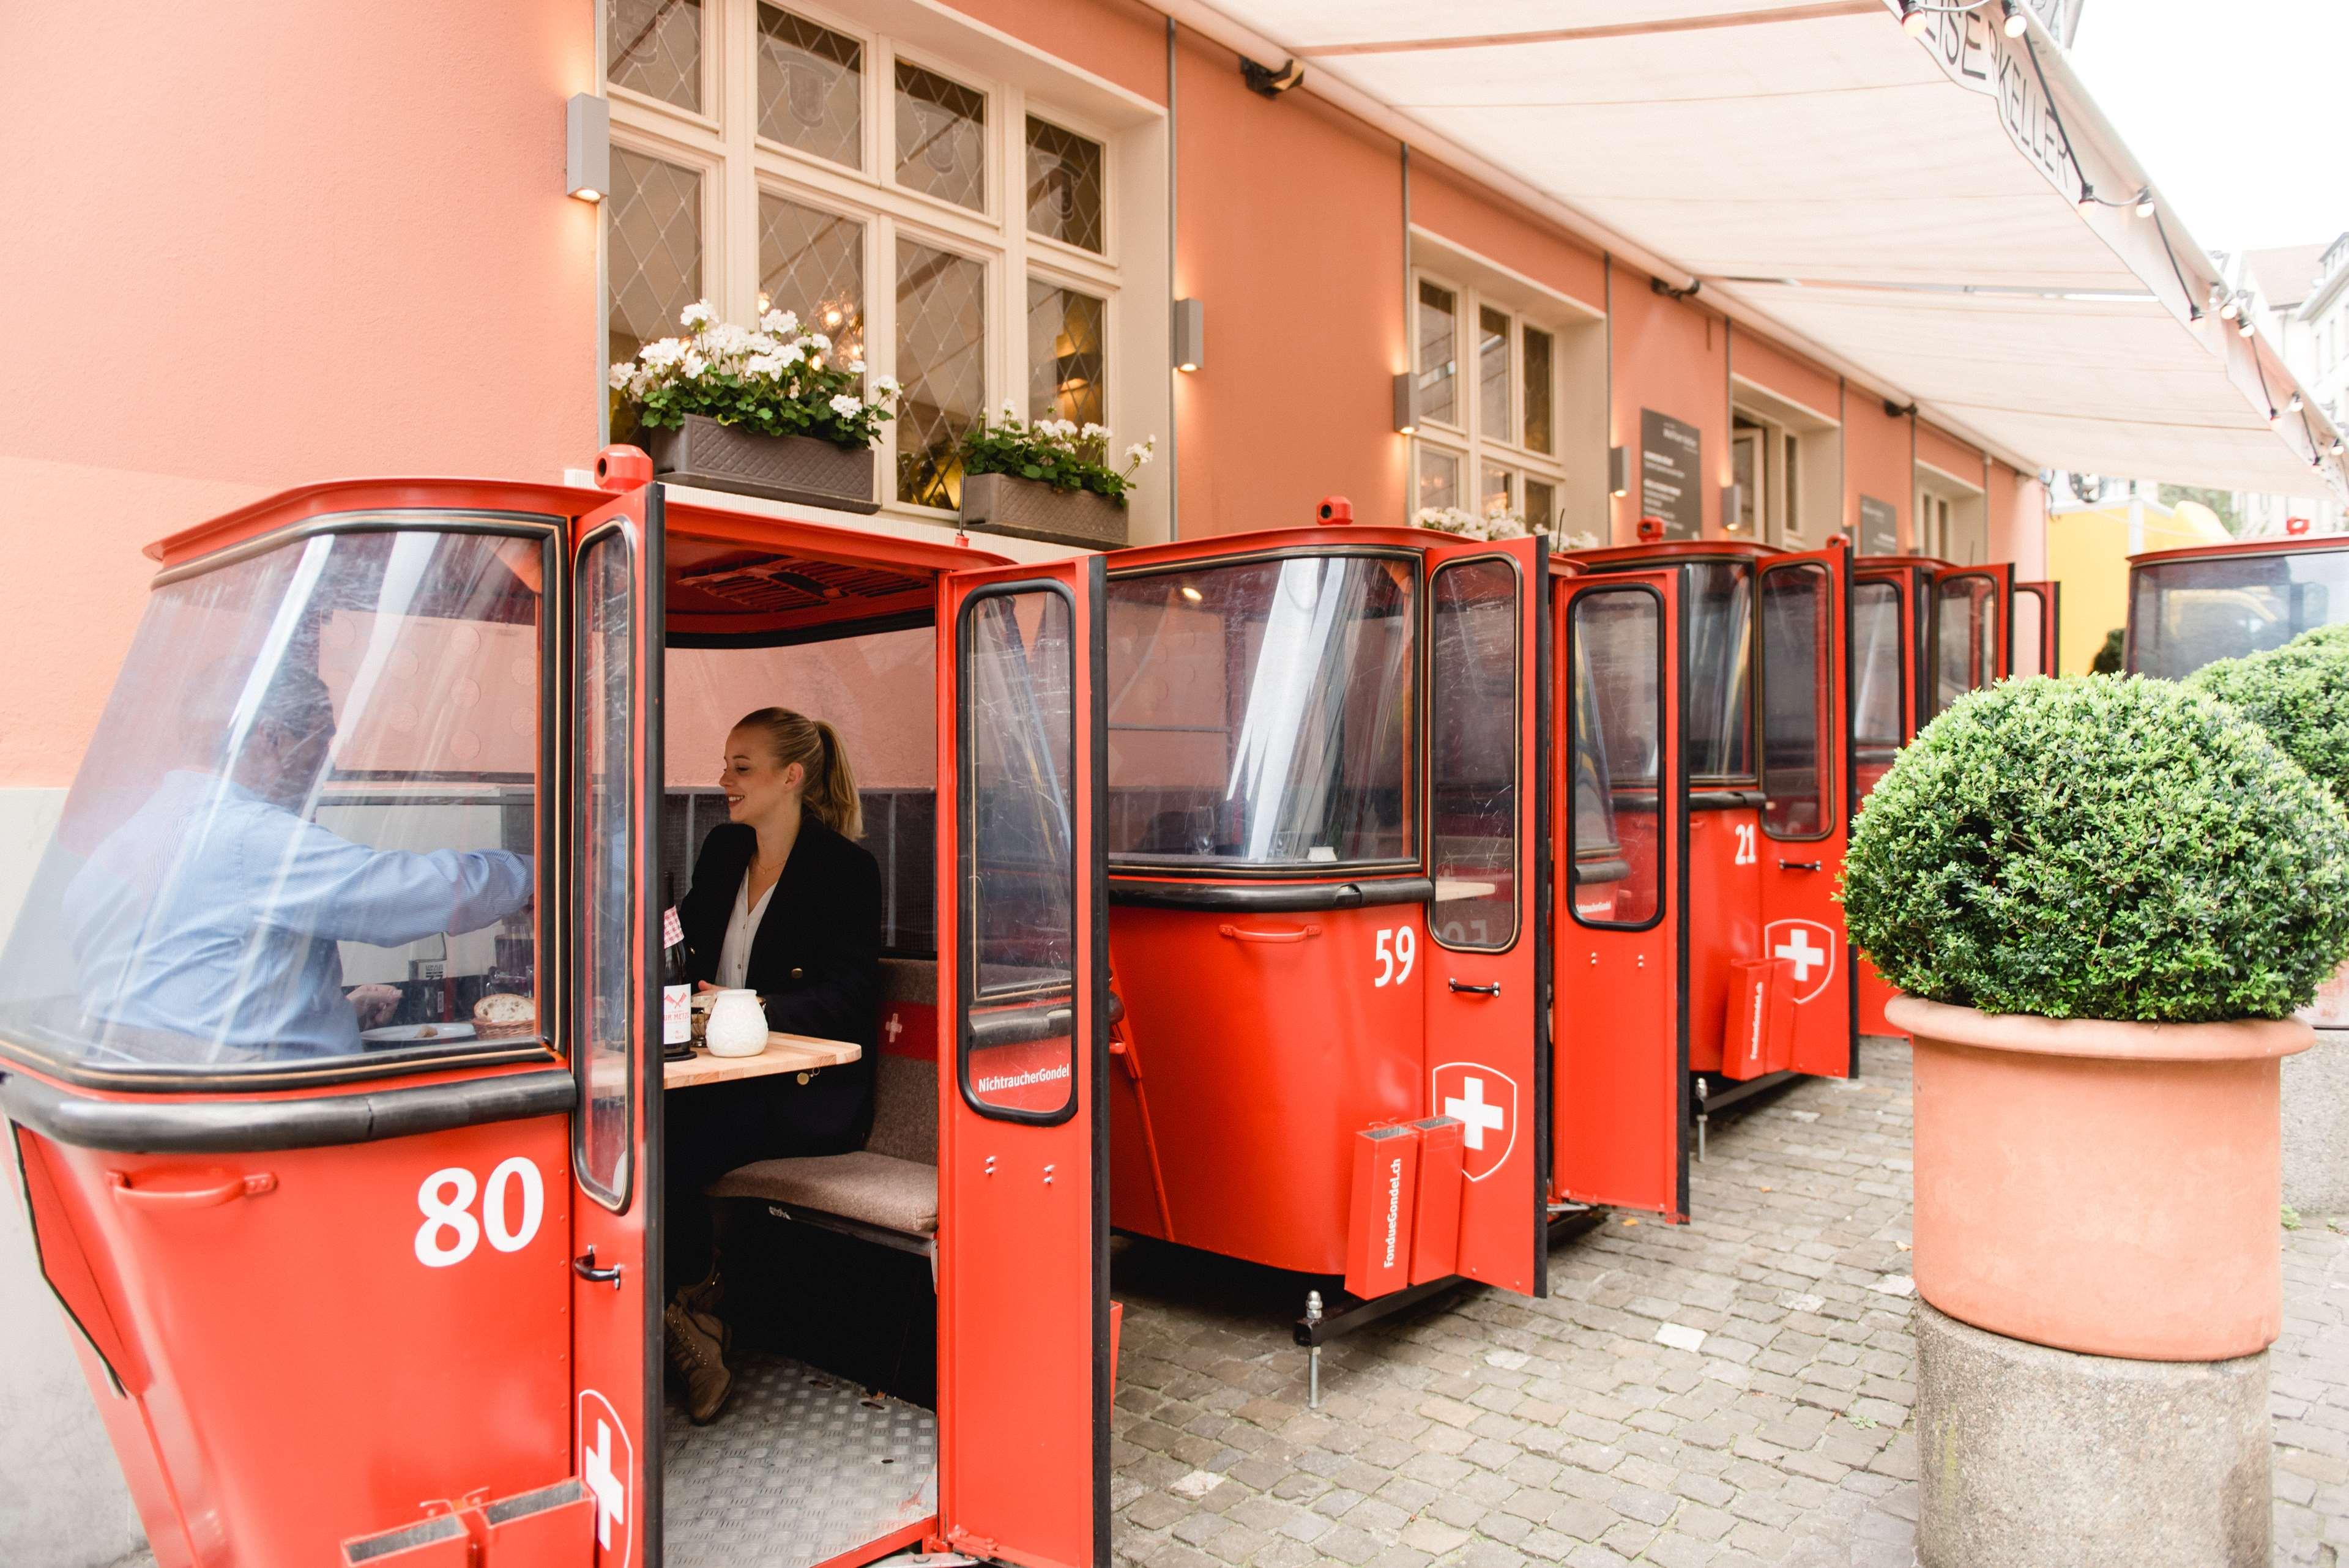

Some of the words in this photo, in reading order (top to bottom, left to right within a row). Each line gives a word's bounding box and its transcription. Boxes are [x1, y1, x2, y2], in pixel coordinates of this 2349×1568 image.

[1735, 823, 1756, 864] 21
[1374, 926, 1415, 987] 59
[978, 1063, 1070, 1093] NichtraucherGondel
[414, 1156, 545, 1268] 80
[1383, 1157, 1401, 1268] FondueGondel.ch
